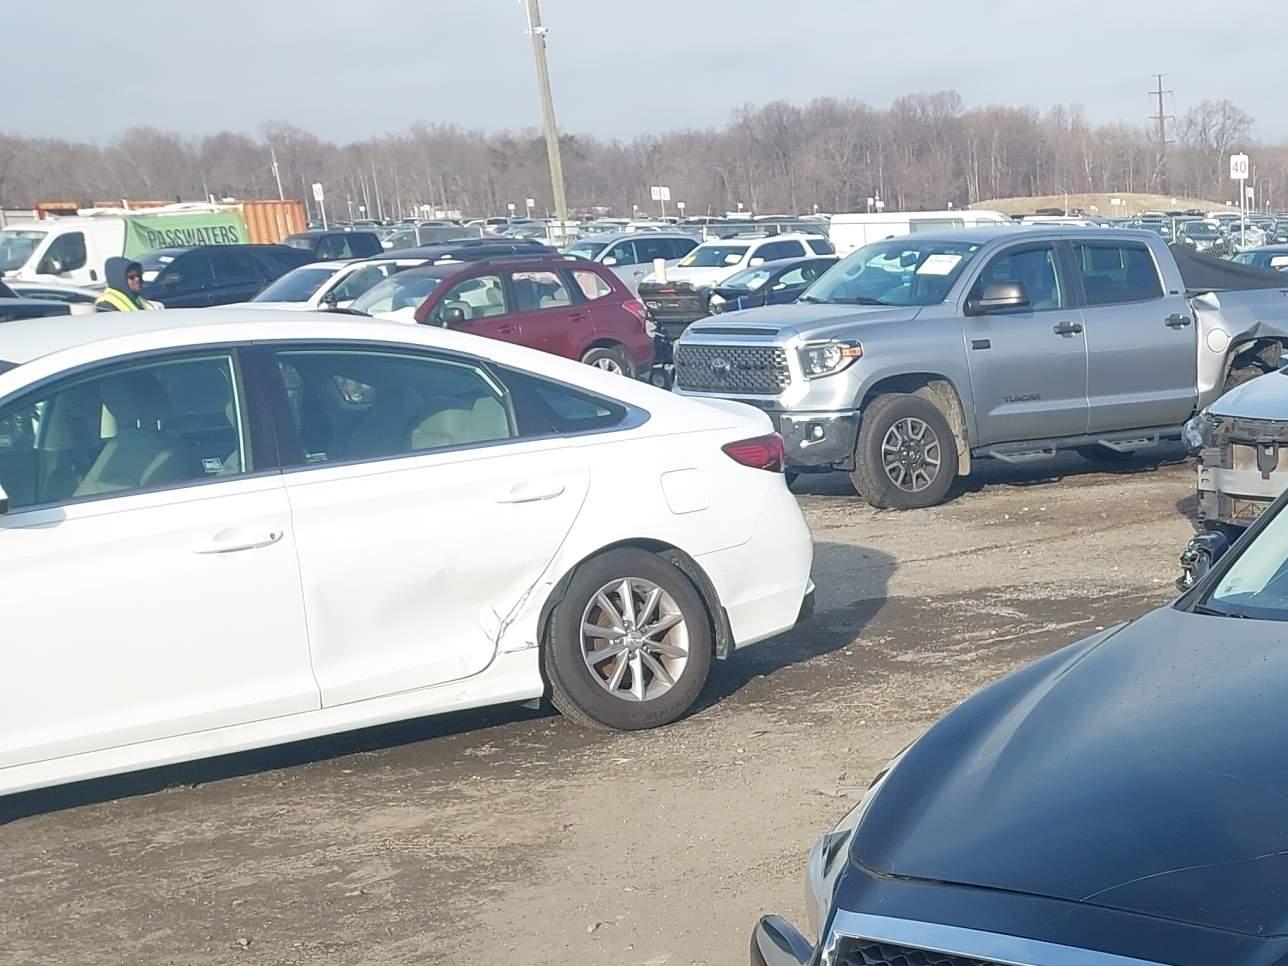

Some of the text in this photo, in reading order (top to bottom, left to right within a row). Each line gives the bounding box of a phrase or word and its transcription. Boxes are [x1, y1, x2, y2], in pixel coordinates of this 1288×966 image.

[1232, 160, 1247, 174] 40
[146, 225, 239, 249] PASSWATERS
[1003, 392, 1041, 403] TUNDRA
